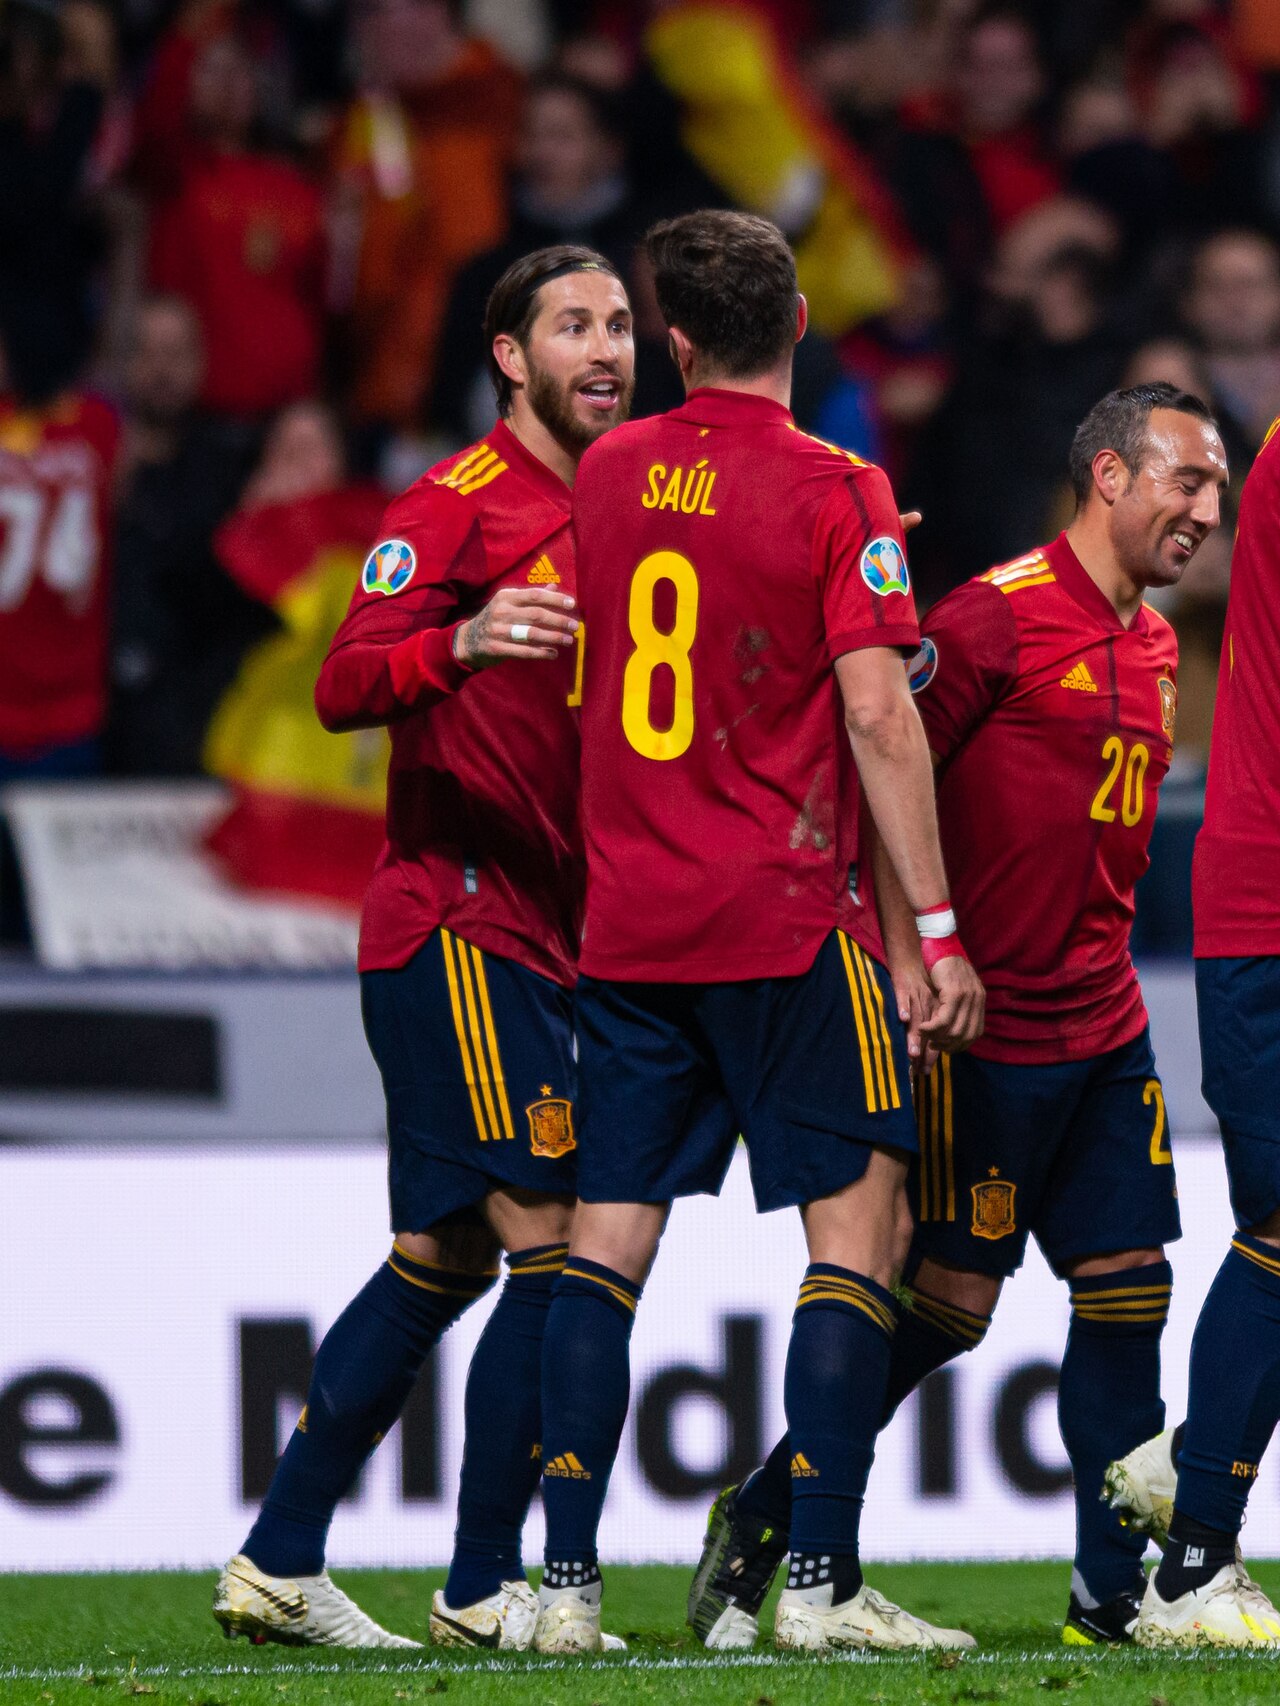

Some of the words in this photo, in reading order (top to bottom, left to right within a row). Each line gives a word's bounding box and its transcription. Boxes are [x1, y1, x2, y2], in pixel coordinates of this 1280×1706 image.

[642, 460, 717, 516] SAÚL
[527, 573, 561, 584] adidas
[622, 551, 699, 761] 8
[1060, 678, 1098, 693] adidas
[1089, 735, 1150, 828] 20
[544, 1467, 592, 1480] adidas
